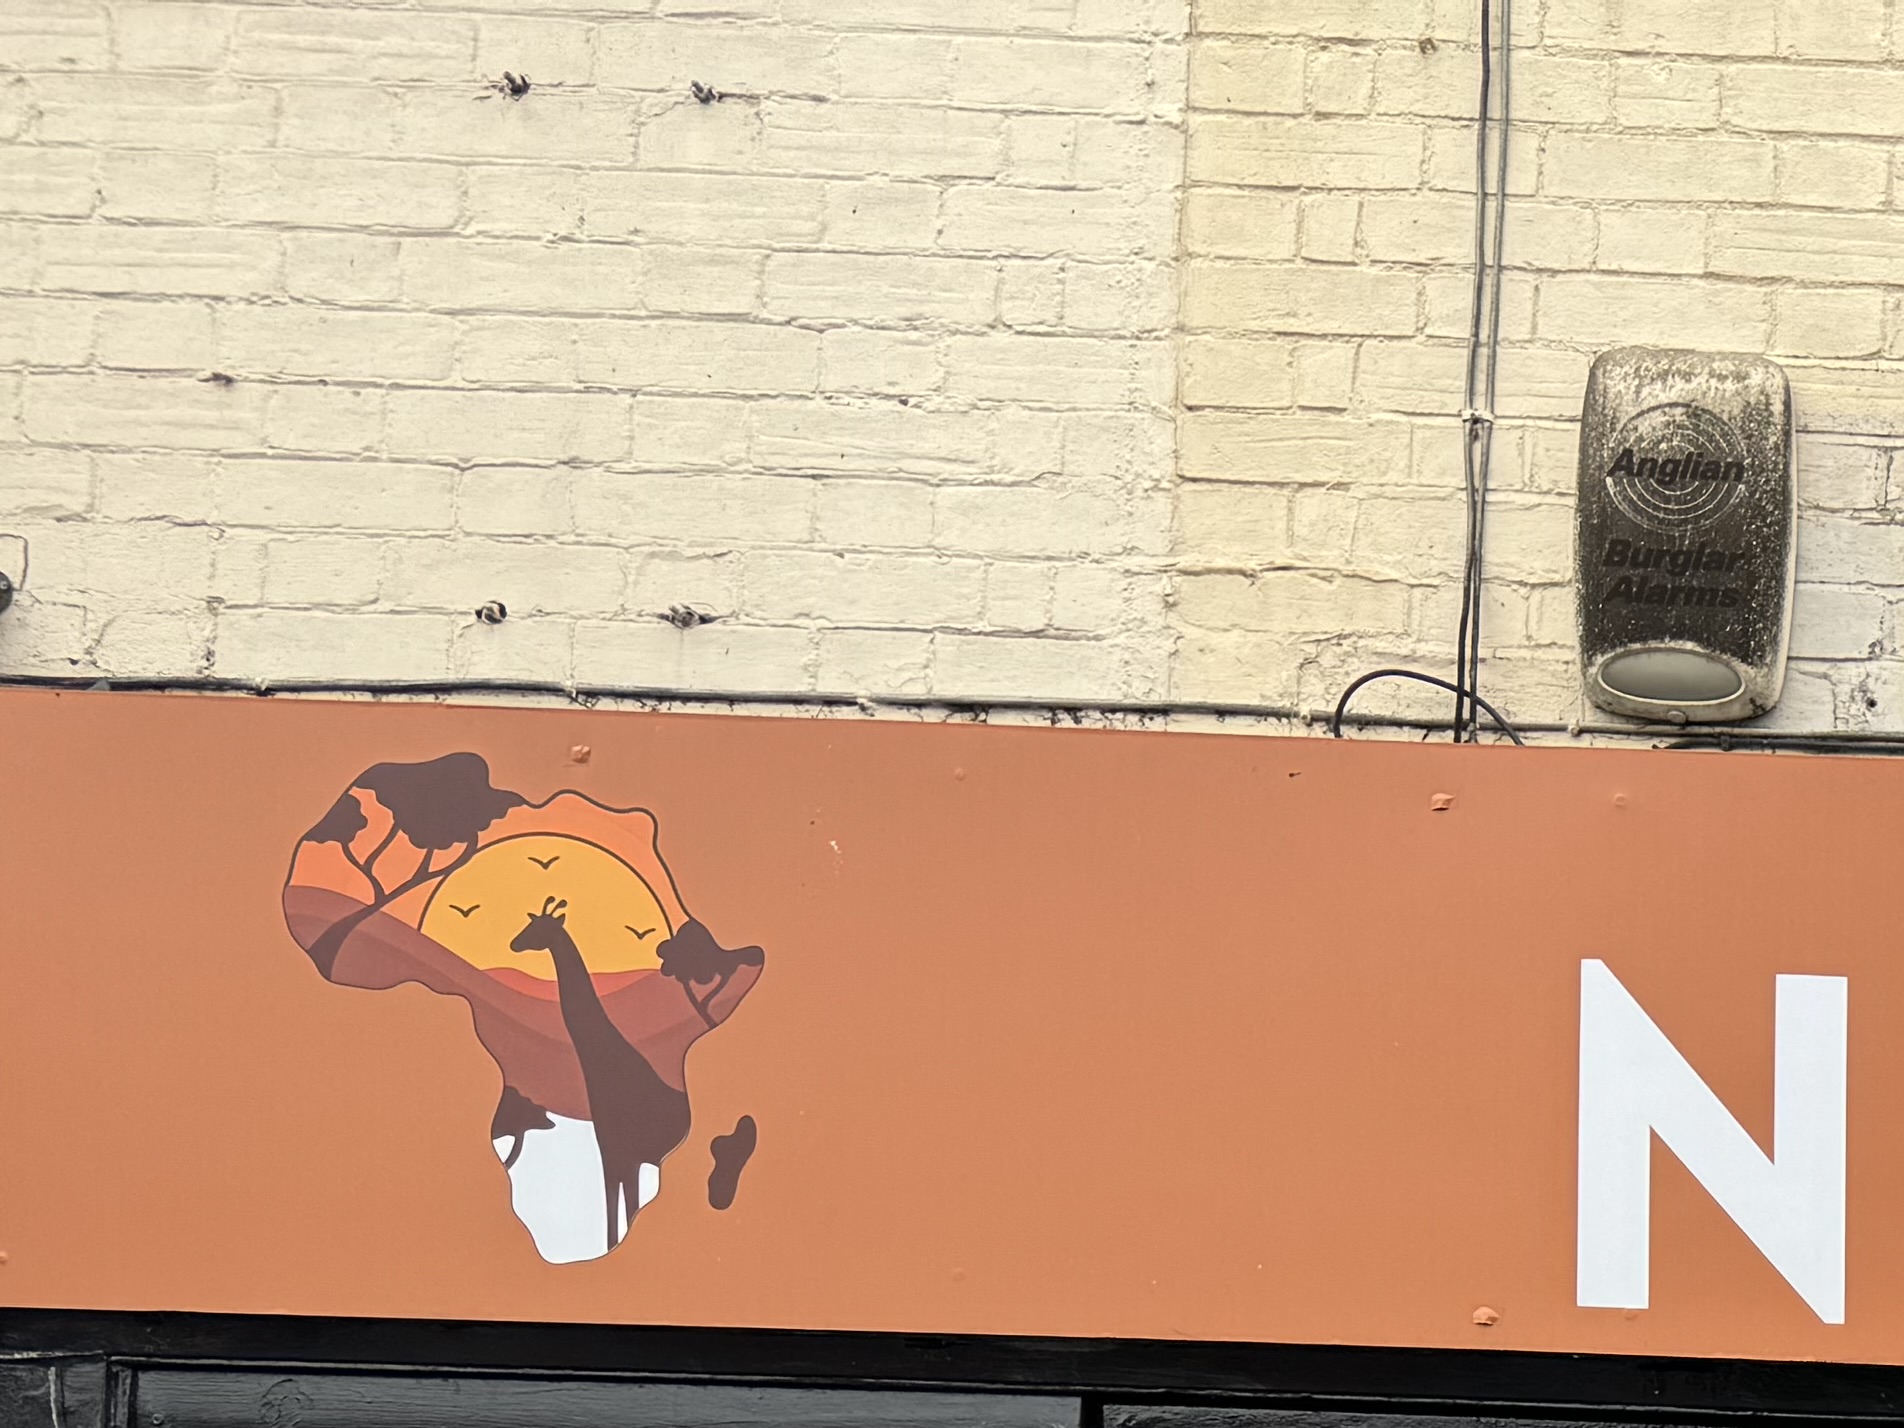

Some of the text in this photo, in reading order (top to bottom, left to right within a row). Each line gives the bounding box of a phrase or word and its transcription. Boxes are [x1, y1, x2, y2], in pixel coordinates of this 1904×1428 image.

[1606, 447, 1745, 487] Anglian
[1602, 538, 1745, 577] Burglar
[1602, 576, 1744, 609] Alarms
